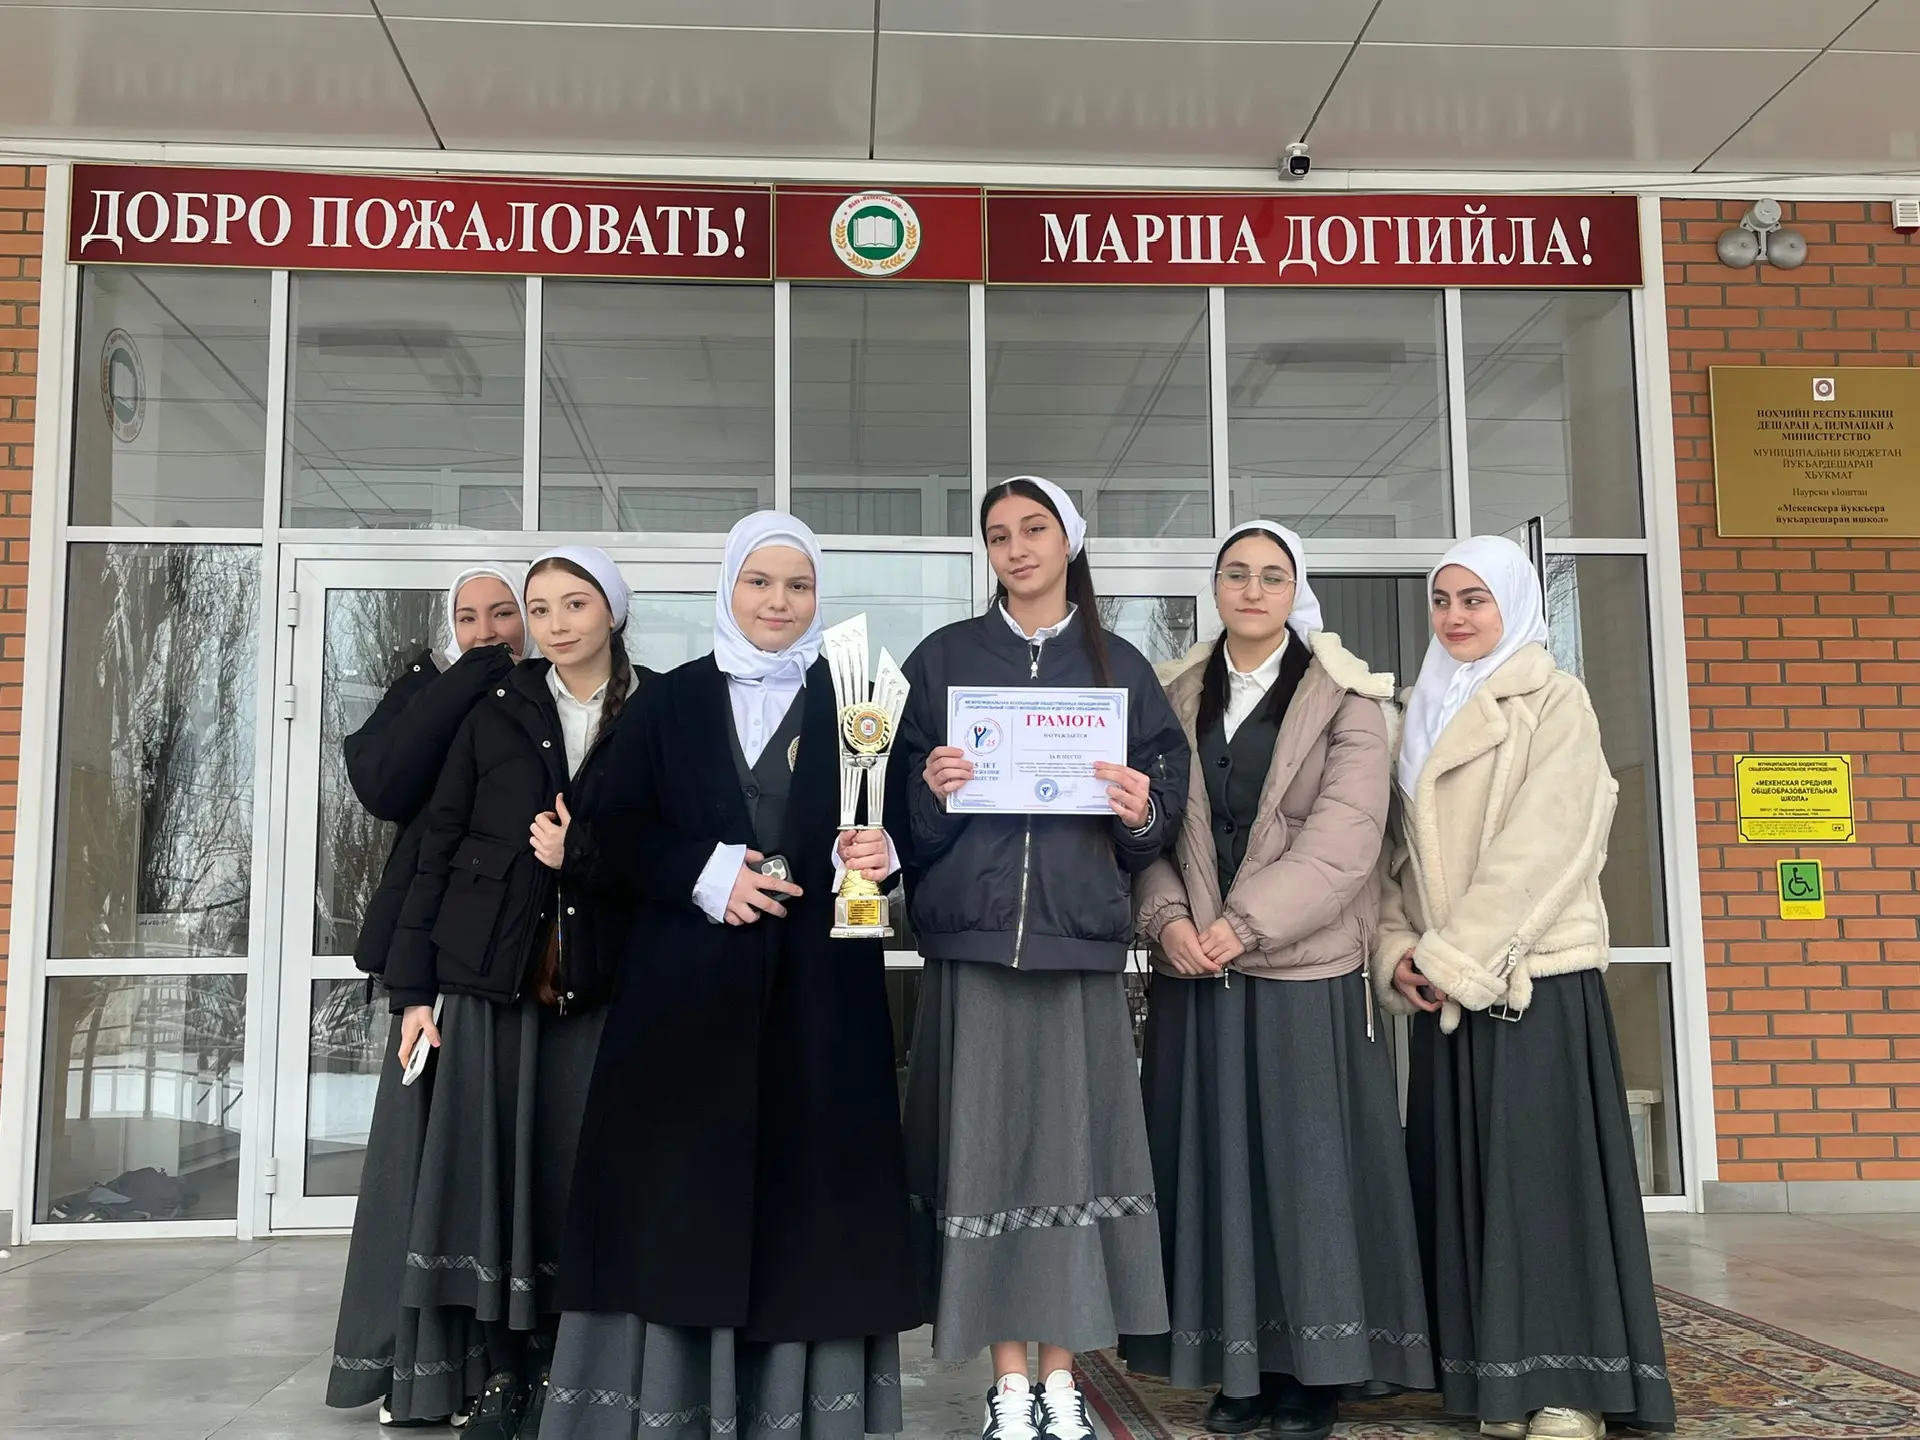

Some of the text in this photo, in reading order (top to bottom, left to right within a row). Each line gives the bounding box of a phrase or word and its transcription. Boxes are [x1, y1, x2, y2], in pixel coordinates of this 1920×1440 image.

[81, 190, 747, 259] ДОБРО ПОЖАЛОВАТЬ!
[1040, 213, 1266, 264] МАРША
[1757, 408, 1894, 419] НОХЧИЙН РЕСПУБЛИКИН
[1757, 421, 1809, 431] ДЕШАРАН
[1887, 421, 1894, 430] А
[1782, 432, 1871, 441] МИНИСТЕРСТВО
[1753, 448, 1902, 458] МУНИЦИПАЛЬНИ БЮДЖЕТАН
[1792, 488, 1829, 498] Наурски
[1026, 714, 1105, 728] ГРАМОТА
[1751, 787, 1838, 795] ОБЩЕОБРАЗОВАТЕЛЬНАЯ
